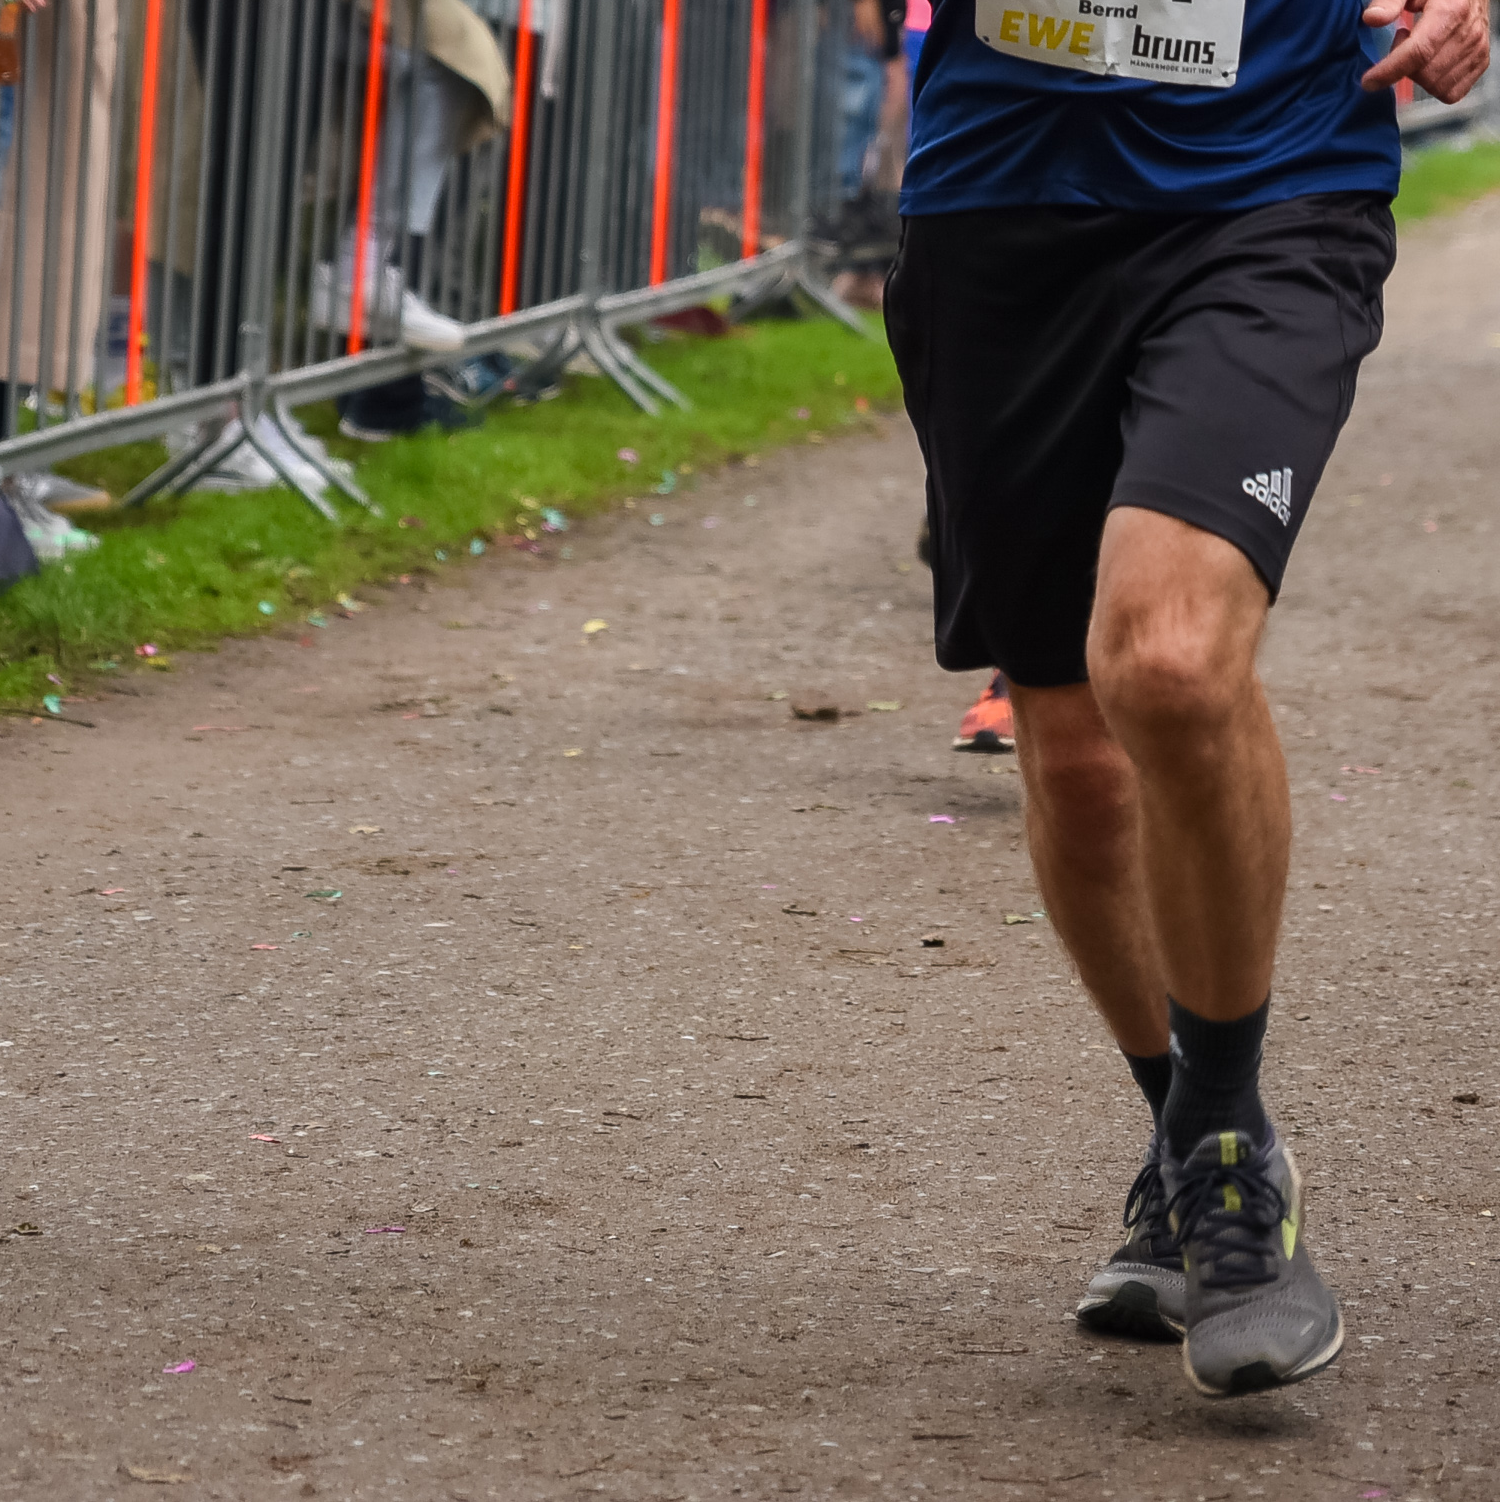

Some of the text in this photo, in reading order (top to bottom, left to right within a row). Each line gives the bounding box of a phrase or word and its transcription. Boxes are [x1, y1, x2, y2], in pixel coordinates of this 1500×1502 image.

[1078, 0, 1138, 19] Bernd
[999, 10, 1095, 56] EWE
[1131, 24, 1216, 65] bruns
[1242, 477, 1291, 527] adidas
